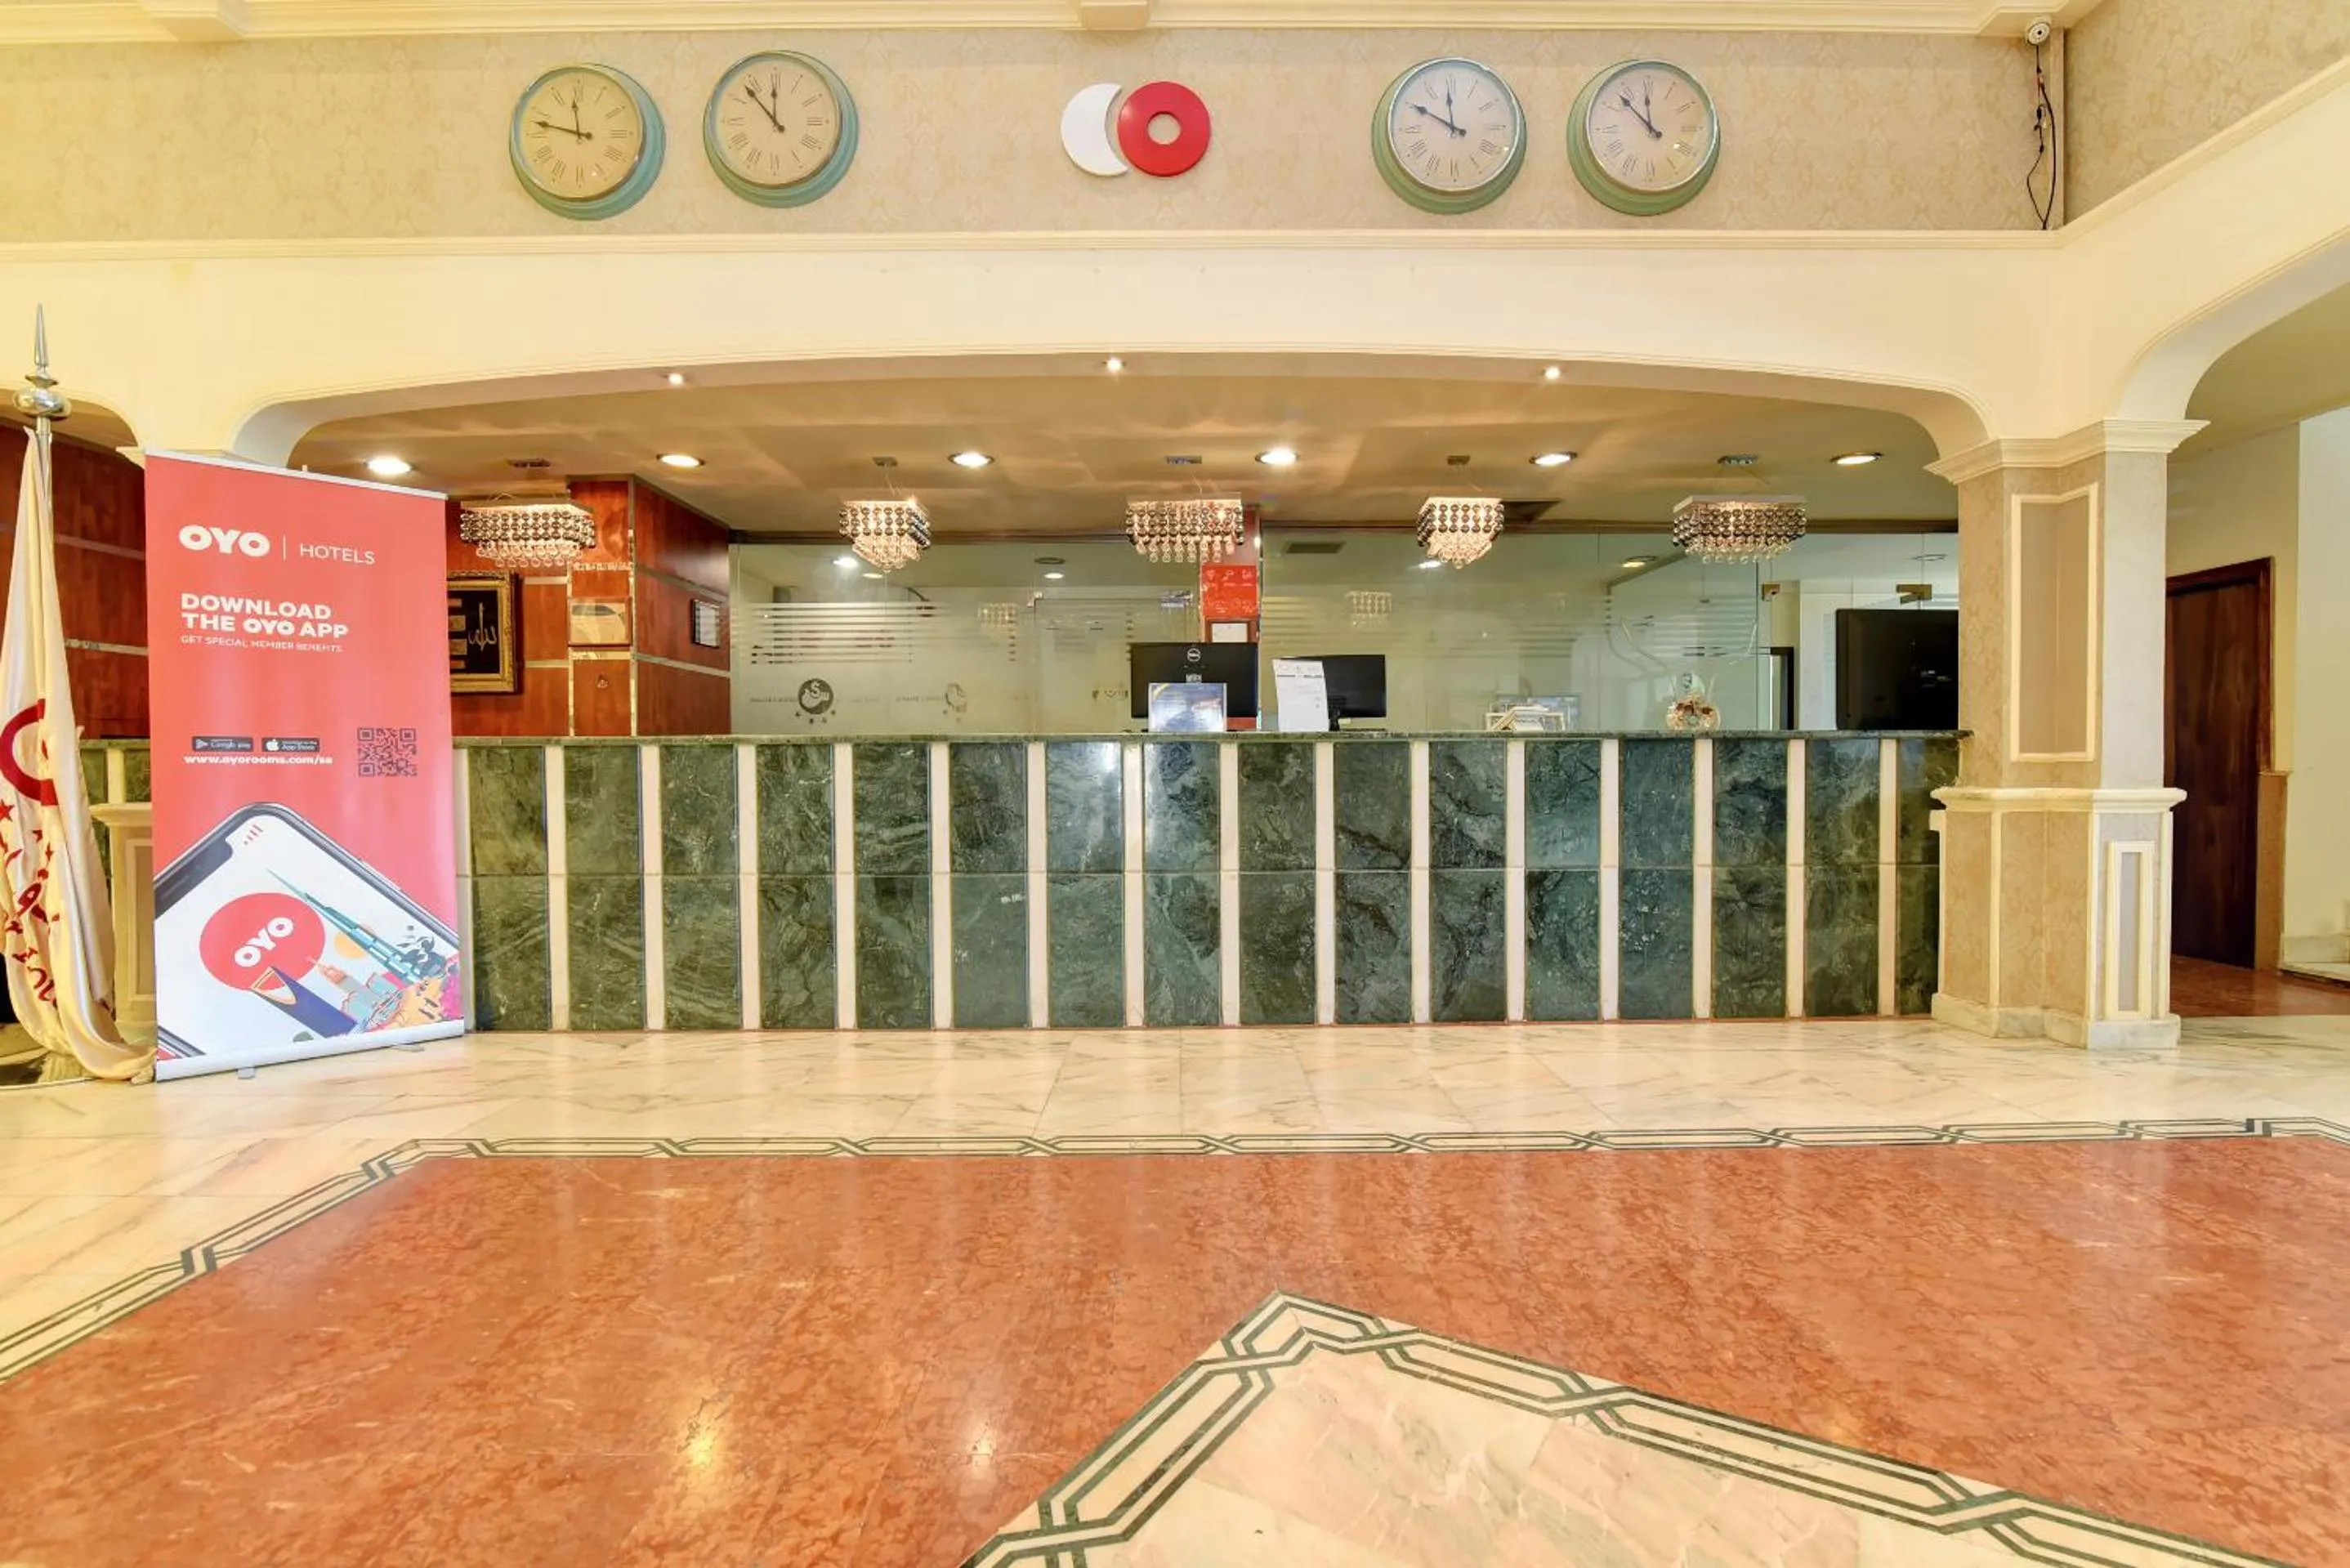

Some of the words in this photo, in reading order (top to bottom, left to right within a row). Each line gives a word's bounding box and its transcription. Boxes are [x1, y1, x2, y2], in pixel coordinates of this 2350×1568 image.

[178, 525, 270, 557] OYO
[300, 543, 376, 565] HOTELS
[181, 593, 332, 619] DOWNLOAD
[181, 612, 235, 632] THE
[243, 618, 295, 635] OYO
[299, 622, 349, 638] APP
[181, 635, 203, 645] GET
[204, 637, 248, 648] SPECIAL
[251, 640, 294, 650] MEMBER
[234, 916, 294, 967] OYO
